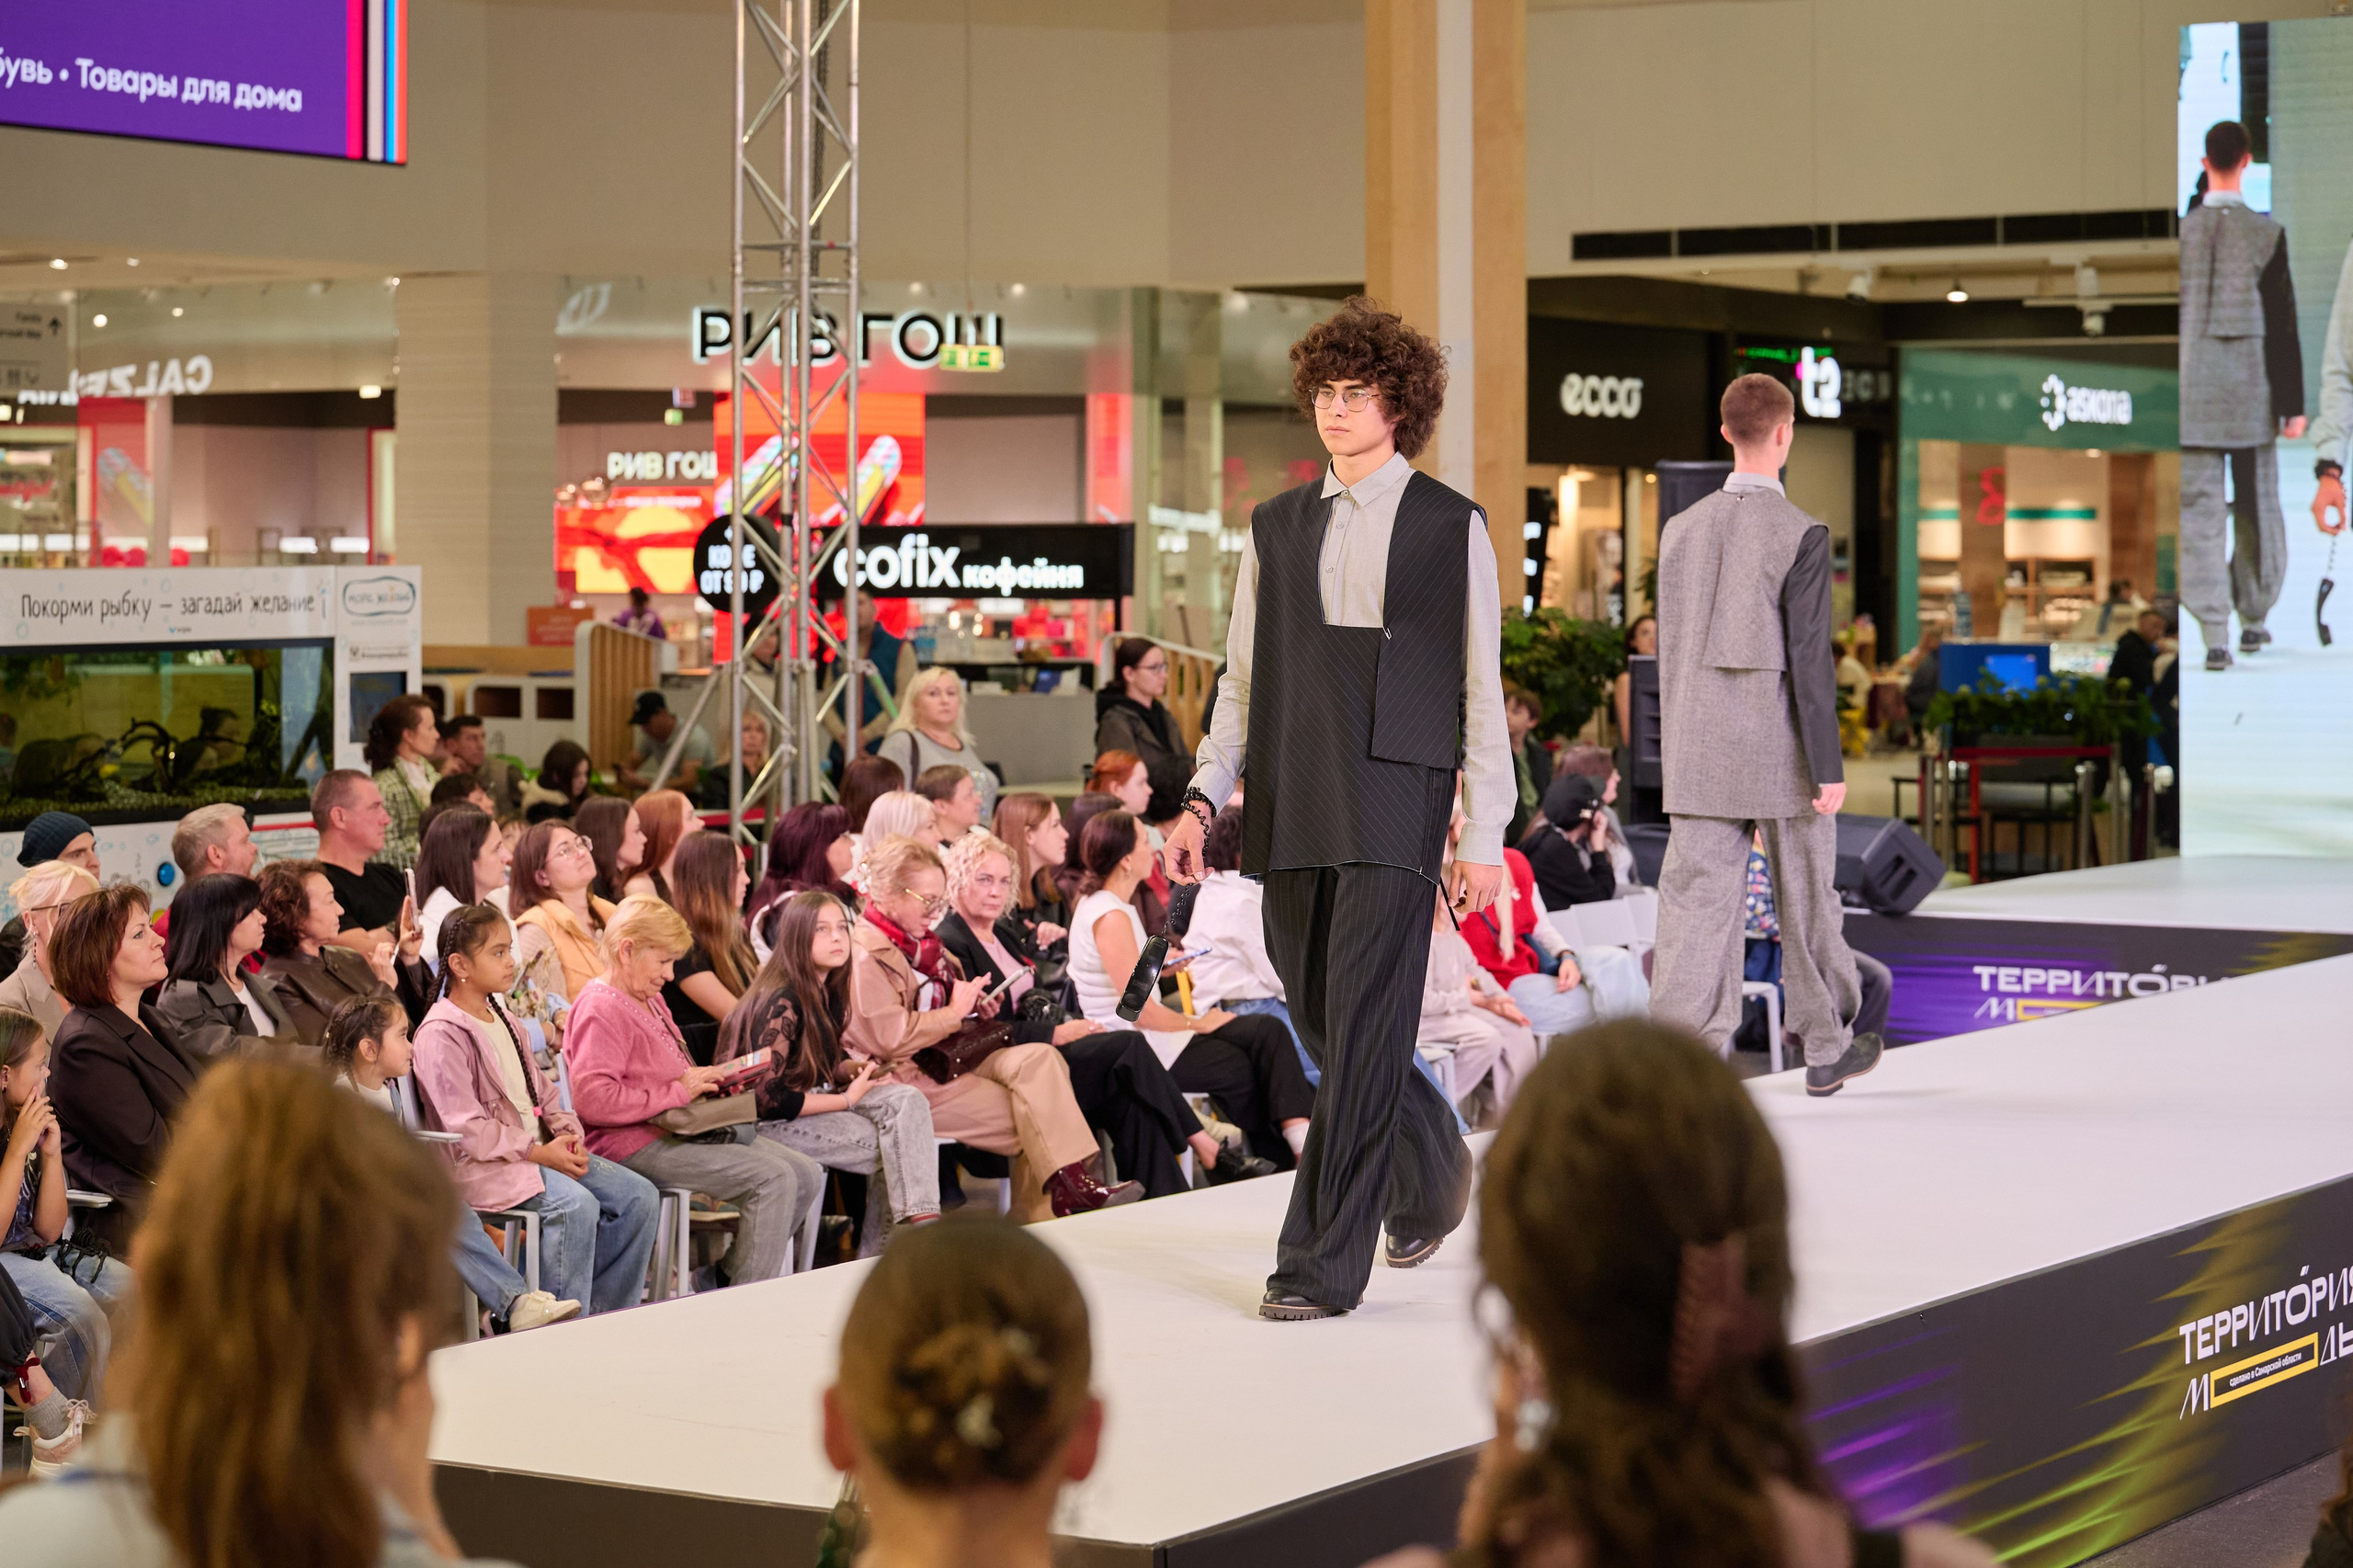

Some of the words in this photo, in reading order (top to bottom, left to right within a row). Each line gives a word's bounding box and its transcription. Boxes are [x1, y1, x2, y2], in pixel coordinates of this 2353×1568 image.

[0, 46, 53, 89] увь
[74, 57, 178, 103] Товары
[182, 76, 231, 106] для
[233, 83, 302, 112] дома
[1559, 371, 1643, 418] ecco
[607, 450, 664, 480] РИВ
[708, 544, 756, 569] КОЕ
[833, 533, 961, 589] cofix
[21, 594, 93, 625] Покорми
[100, 589, 152, 624] рыбку
[180, 592, 243, 617] загадай
[249, 594, 314, 616] желание
[2229, 1372, 2251, 1387] сделано
[2255, 1358, 2282, 1377] Самарской
[2281, 1352, 2302, 1368] области
